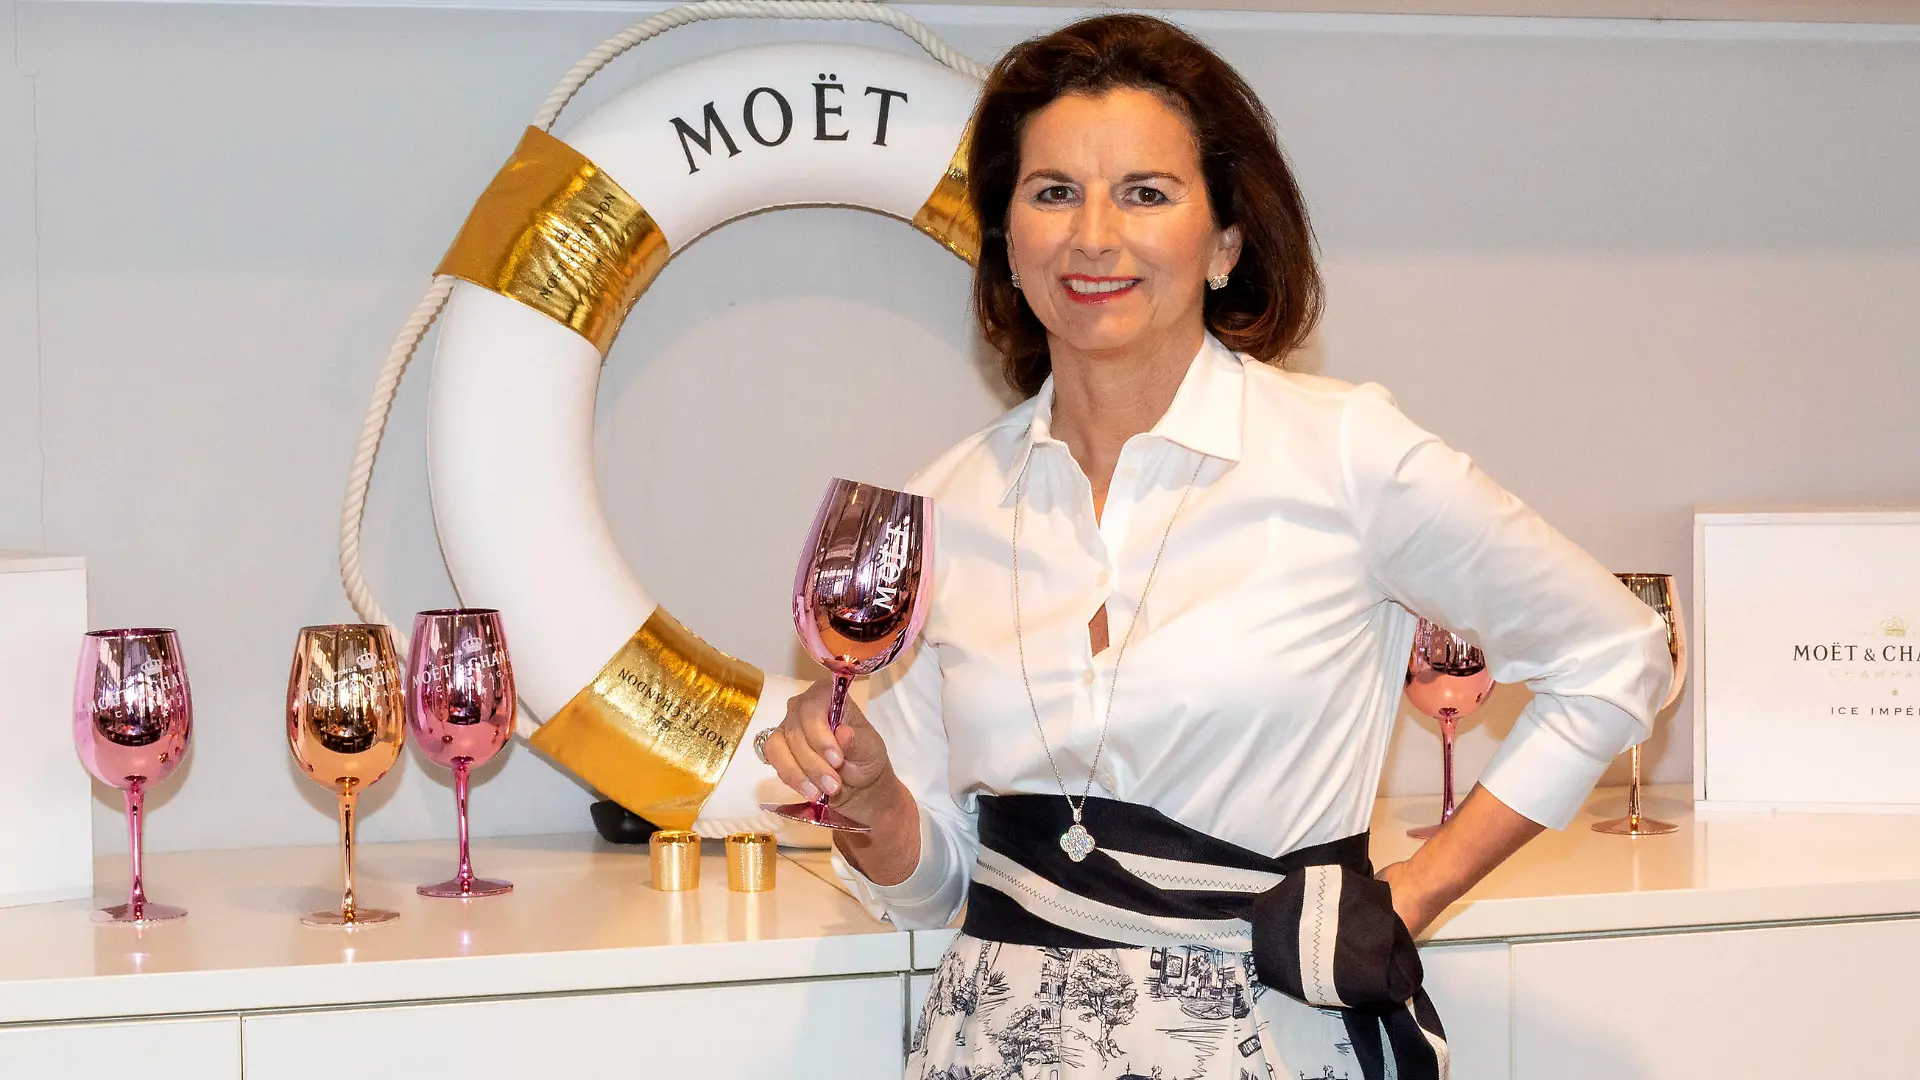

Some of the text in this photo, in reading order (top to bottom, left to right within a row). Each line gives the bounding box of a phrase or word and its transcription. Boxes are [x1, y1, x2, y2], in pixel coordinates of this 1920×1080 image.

[668, 73, 909, 175] MOËT
[569, 192, 617, 253] CHANDON
[1792, 641, 1920, 661] MOËT & CH
[1829, 668, 1920, 679] CHAMPA
[618, 668, 680, 718] CHANDON
[1831, 705, 1920, 716] ICE IMPÉ
